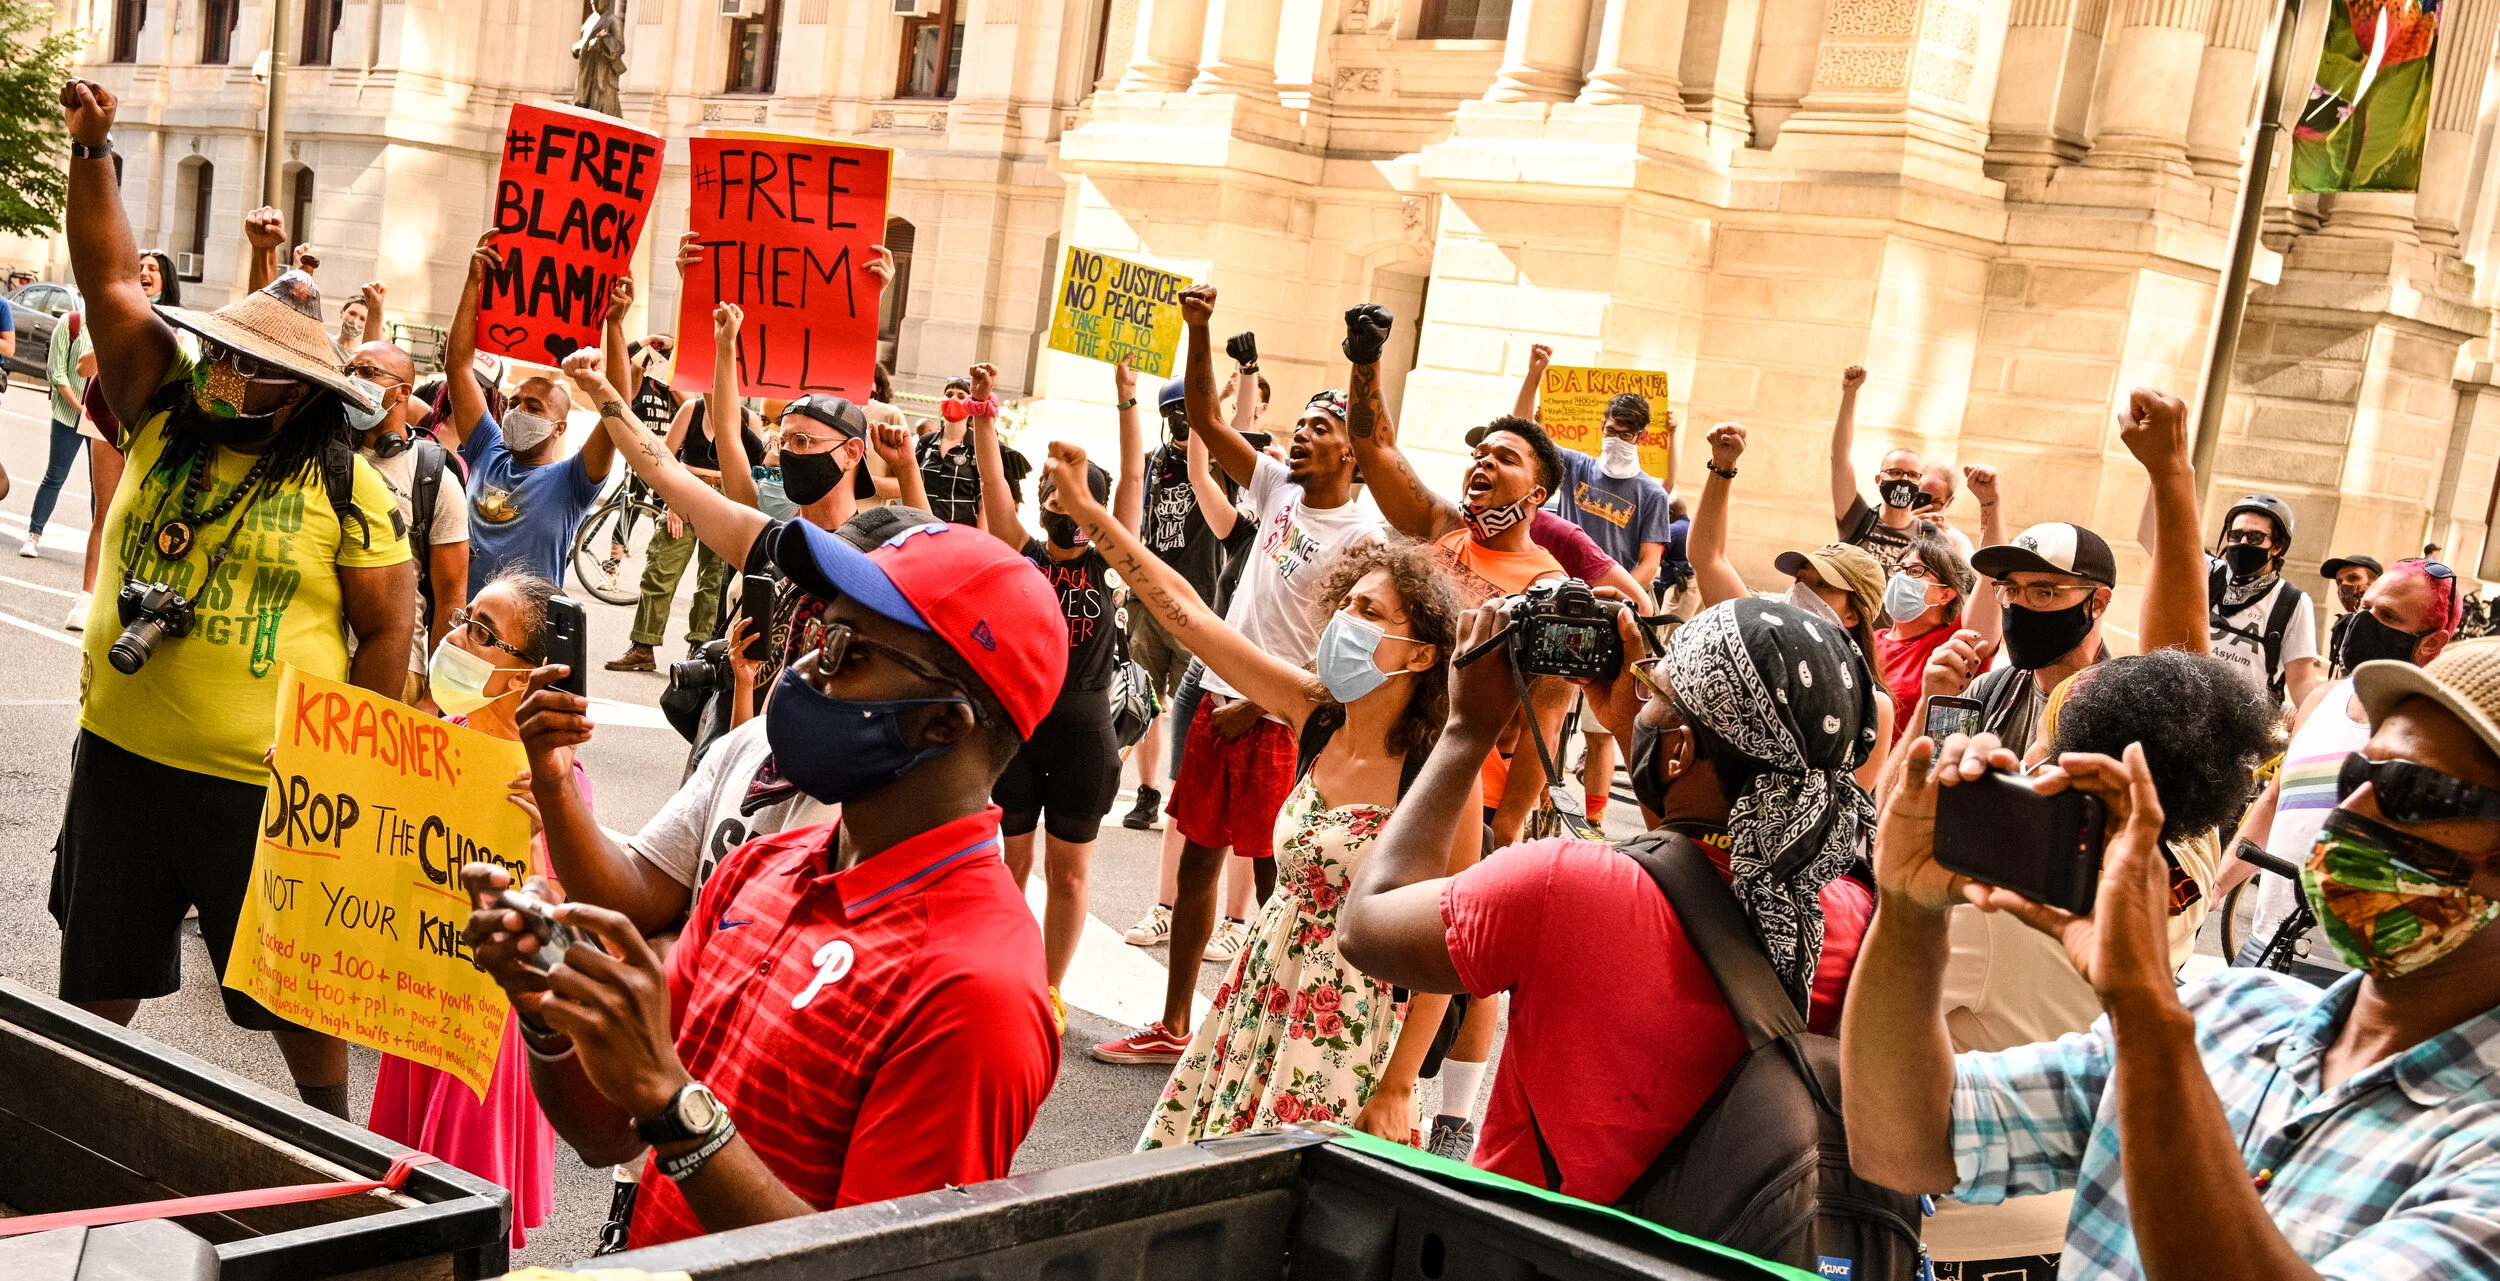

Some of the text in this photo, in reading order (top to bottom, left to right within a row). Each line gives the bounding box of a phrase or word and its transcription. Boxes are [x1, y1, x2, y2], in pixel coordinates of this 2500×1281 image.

[506, 124, 655, 202] #FREE
[694, 149, 860, 231] #FREE
[496, 180, 635, 259] BLACK
[690, 240, 855, 319] THEM
[1065, 280, 1156, 329] NO PEACE
[1071, 250, 1182, 306] NO JUSTICE
[1070, 308, 1152, 348] TAKE IT TO
[1075, 332, 1102, 360] THE
[1546, 369, 1668, 399] DA KRASNER
[1545, 424, 1588, 442] DROP
[1157, 501, 1192, 516] BLACK
[2248, 612, 2263, 620] 612
[2211, 646, 2251, 666] Asylum
[294, 682, 462, 787] KRASNER:
[264, 765, 360, 848] DROP
[371, 804, 416, 856] THE
[264, 869, 303, 911] NOT
[320, 881, 398, 941] YOUR
[257, 956, 297, 996] Charged
[365, 994, 387, 1018] ppl
[393, 1002, 405, 1016] in
[411, 1011, 437, 1028] past
[440, 1016, 451, 1034] 2
[454, 1023, 476, 1052] days
[260, 923, 504, 1025] Locked up 100+ Black youth during
[791, 939, 855, 1010] P
[267, 995, 315, 1027] requesting
[320, 1008, 350, 1036] high
[355, 1019, 390, 1044] bails
[393, 1035, 402, 1046] +
[405, 1031, 443, 1067] fueling
[678, 1152, 701, 1168] BLACK
[1819, 1260, 1850, 1276] Acuvar
